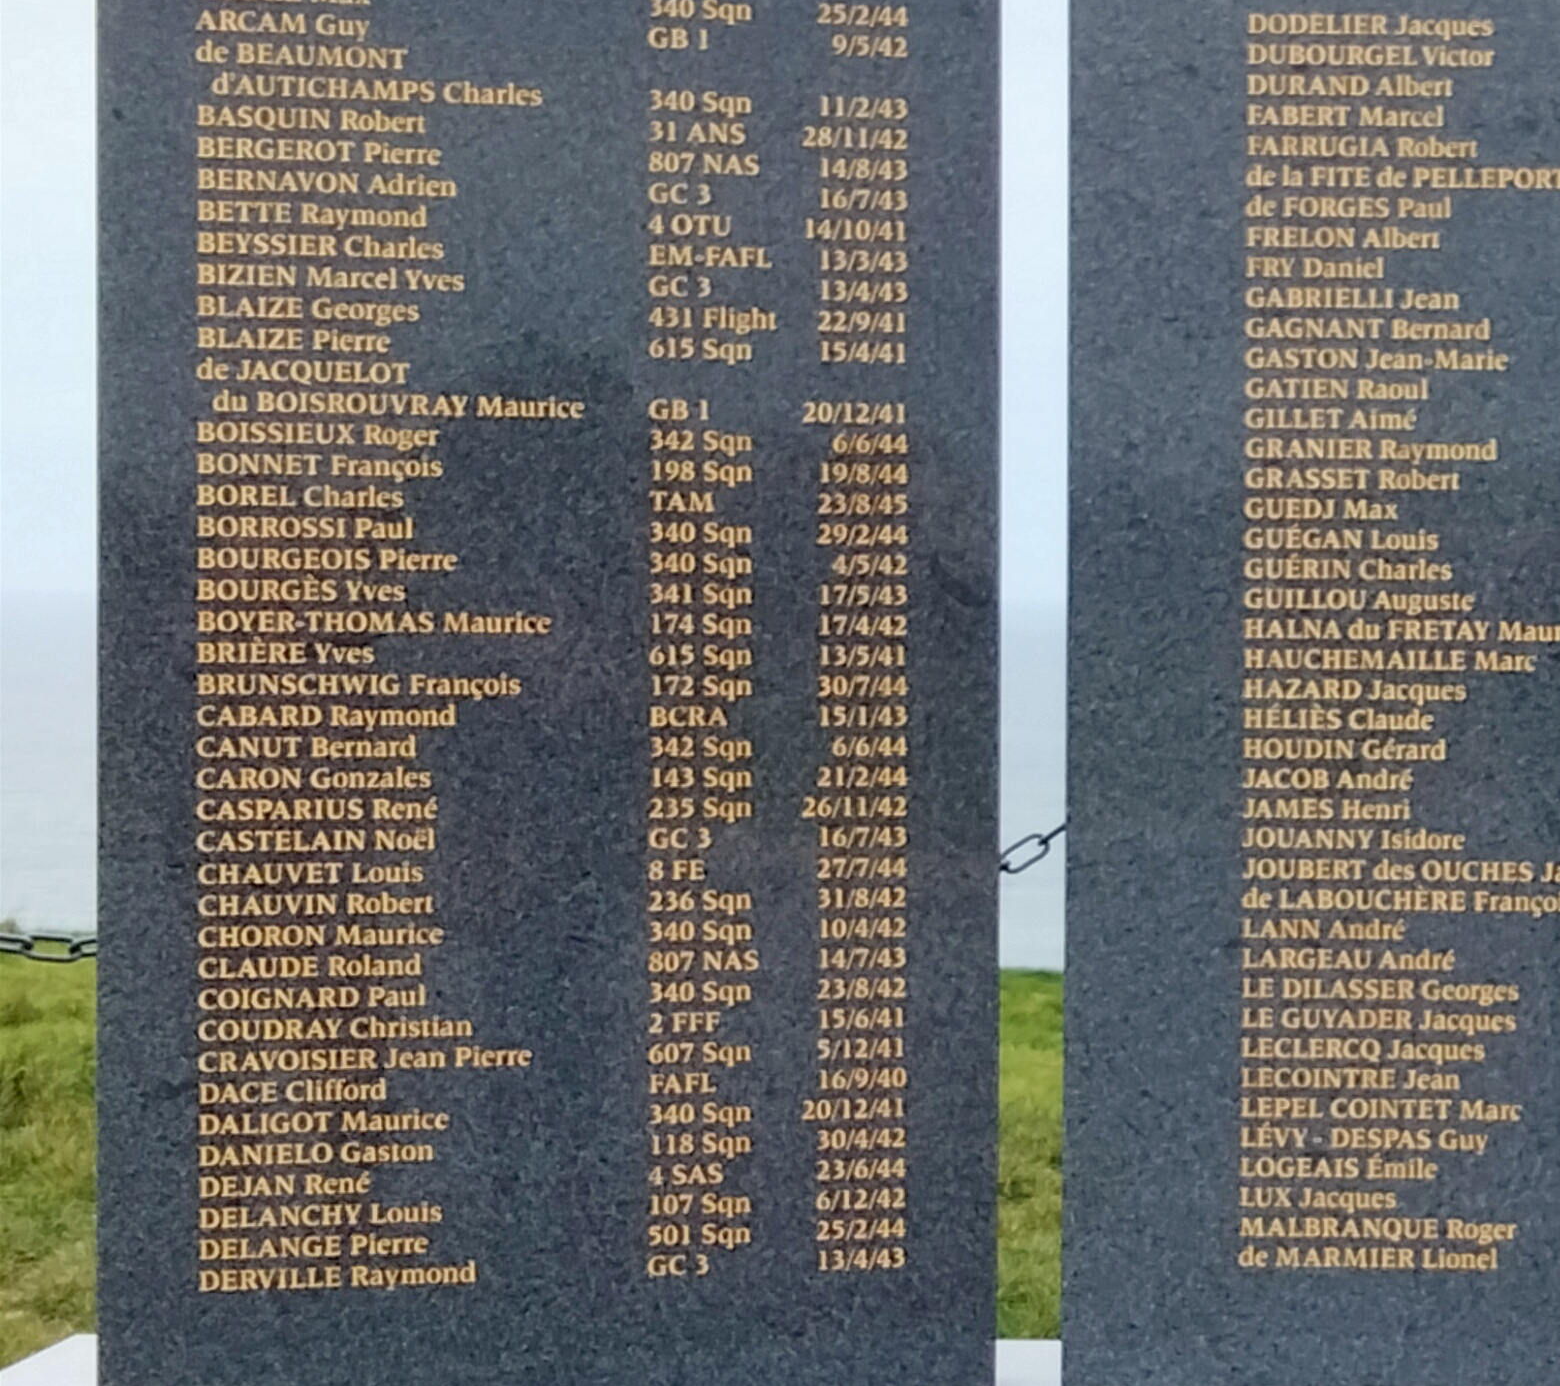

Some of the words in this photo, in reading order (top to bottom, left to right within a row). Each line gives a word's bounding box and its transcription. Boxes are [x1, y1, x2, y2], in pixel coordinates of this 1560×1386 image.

[818, 3, 908, 27] 25/2/44
[1248, 13, 1387, 34] DODELIER
[1395, 15, 1494, 41] Jacques
[198, 105, 330, 131] BASQUIN
[341, 109, 425, 133] Robert
[651, 121, 676, 141] 31
[687, 122, 745, 145] ANS
[803, 126, 907, 150] 28/11/42
[1248, 104, 1350, 126] FABERT
[1360, 106, 1443, 127] Marcel
[197, 232, 337, 256] BEYSSIER
[343, 235, 444, 259] Charles
[649, 245, 771, 268] EM-FAFL
[821, 249, 907, 272] 13/3/43
[1246, 287, 1392, 308] GABRIELLI
[1401, 289, 1459, 309] Jean
[1245, 378, 1348, 399] GATIEN
[1358, 379, 1428, 399] Raoul
[197, 422, 354, 444] BOISSIEUX
[364, 424, 439, 452] Roger
[651, 429, 694, 451] 342
[703, 430, 752, 457] Sqn
[832, 433, 908, 454] 6/6/44
[1245, 468, 1369, 489] GRASSET
[1379, 469, 1459, 490] Robert
[197, 610, 434, 633] BOYER-THOMAS
[444, 611, 551, 634] Maurice
[652, 613, 694, 634] 174
[702, 613, 752, 640] Sqn
[820, 615, 907, 636] 17/4/42
[1243, 678, 1362, 700] HAZARD
[1368, 680, 1466, 706] Jacques
[196, 705, 323, 727] CABARD
[330, 703, 456, 731] Raymond
[650, 706, 727, 728] BCRA
[820, 705, 907, 728] 15/1/43
[195, 798, 363, 821] CASPARIUS
[372, 797, 438, 821] René
[649, 797, 694, 819] 235
[703, 797, 751, 823] Sqn
[801, 796, 907, 818] 26/11/42
[1243, 858, 1365, 880] JOUBERT
[1373, 859, 1415, 881] des
[1421, 860, 1533, 882] OUCHES
[198, 956, 318, 979] CLAUDE
[329, 953, 422, 977] Roland
[648, 951, 694, 973] 807
[703, 950, 759, 971] NAS
[820, 947, 906, 969] 14/7/43
[1242, 1038, 1381, 1062] LECLERCQ
[1387, 1040, 1485, 1065] Jacques
[199, 1142, 333, 1167] DANIELO
[340, 1141, 434, 1163] Gaston
[652, 1133, 694, 1155] 118
[702, 1132, 751, 1158] Sqn
[818, 1127, 906, 1150] 30/4/42
[1238, 1245, 1268, 1267] de
[1276, 1247, 1414, 1269] MARMIER
[1422, 1248, 1497, 1271] Lionel
